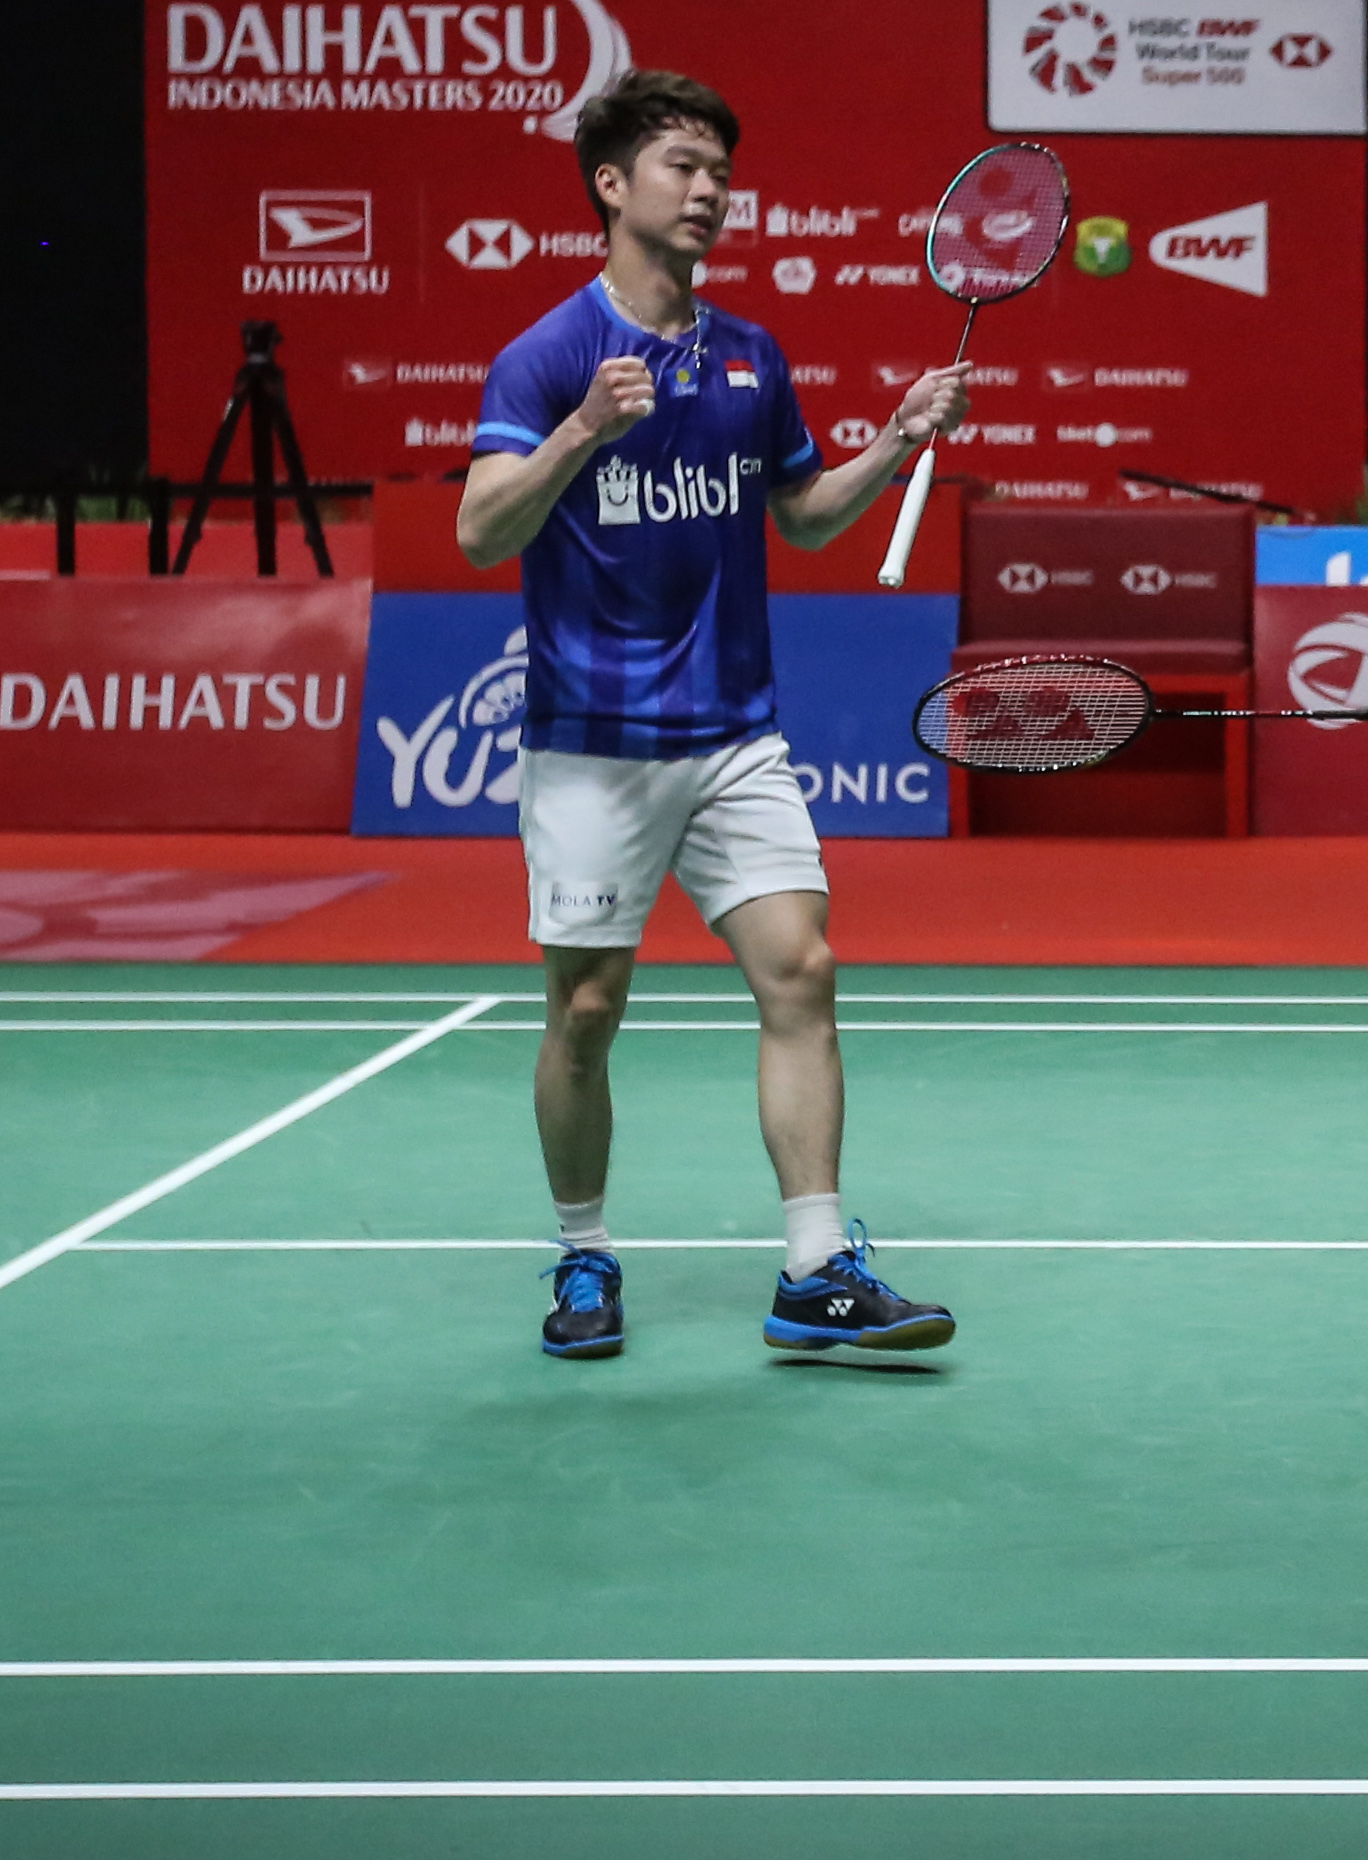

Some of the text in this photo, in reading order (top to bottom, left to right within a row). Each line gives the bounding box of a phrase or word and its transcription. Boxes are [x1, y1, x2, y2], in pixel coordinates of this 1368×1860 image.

[166, 3, 557, 76] DAIHATSU
[1128, 18, 1261, 38] HSBC BWF
[1135, 42, 1250, 61] World Tour
[1142, 66, 1202, 88] Super
[168, 79, 564, 111] INDONESIA MASTERS 2020
[539, 231, 609, 258] HSBC
[1165, 235, 1256, 259] BWF
[242, 266, 390, 295] DAIHATSU
[867, 264, 921, 286] YONEX
[1094, 368, 1188, 388] DAIHATSU
[981, 424, 1037, 445] YONEX
[0, 672, 347, 731] DAIHATSU
